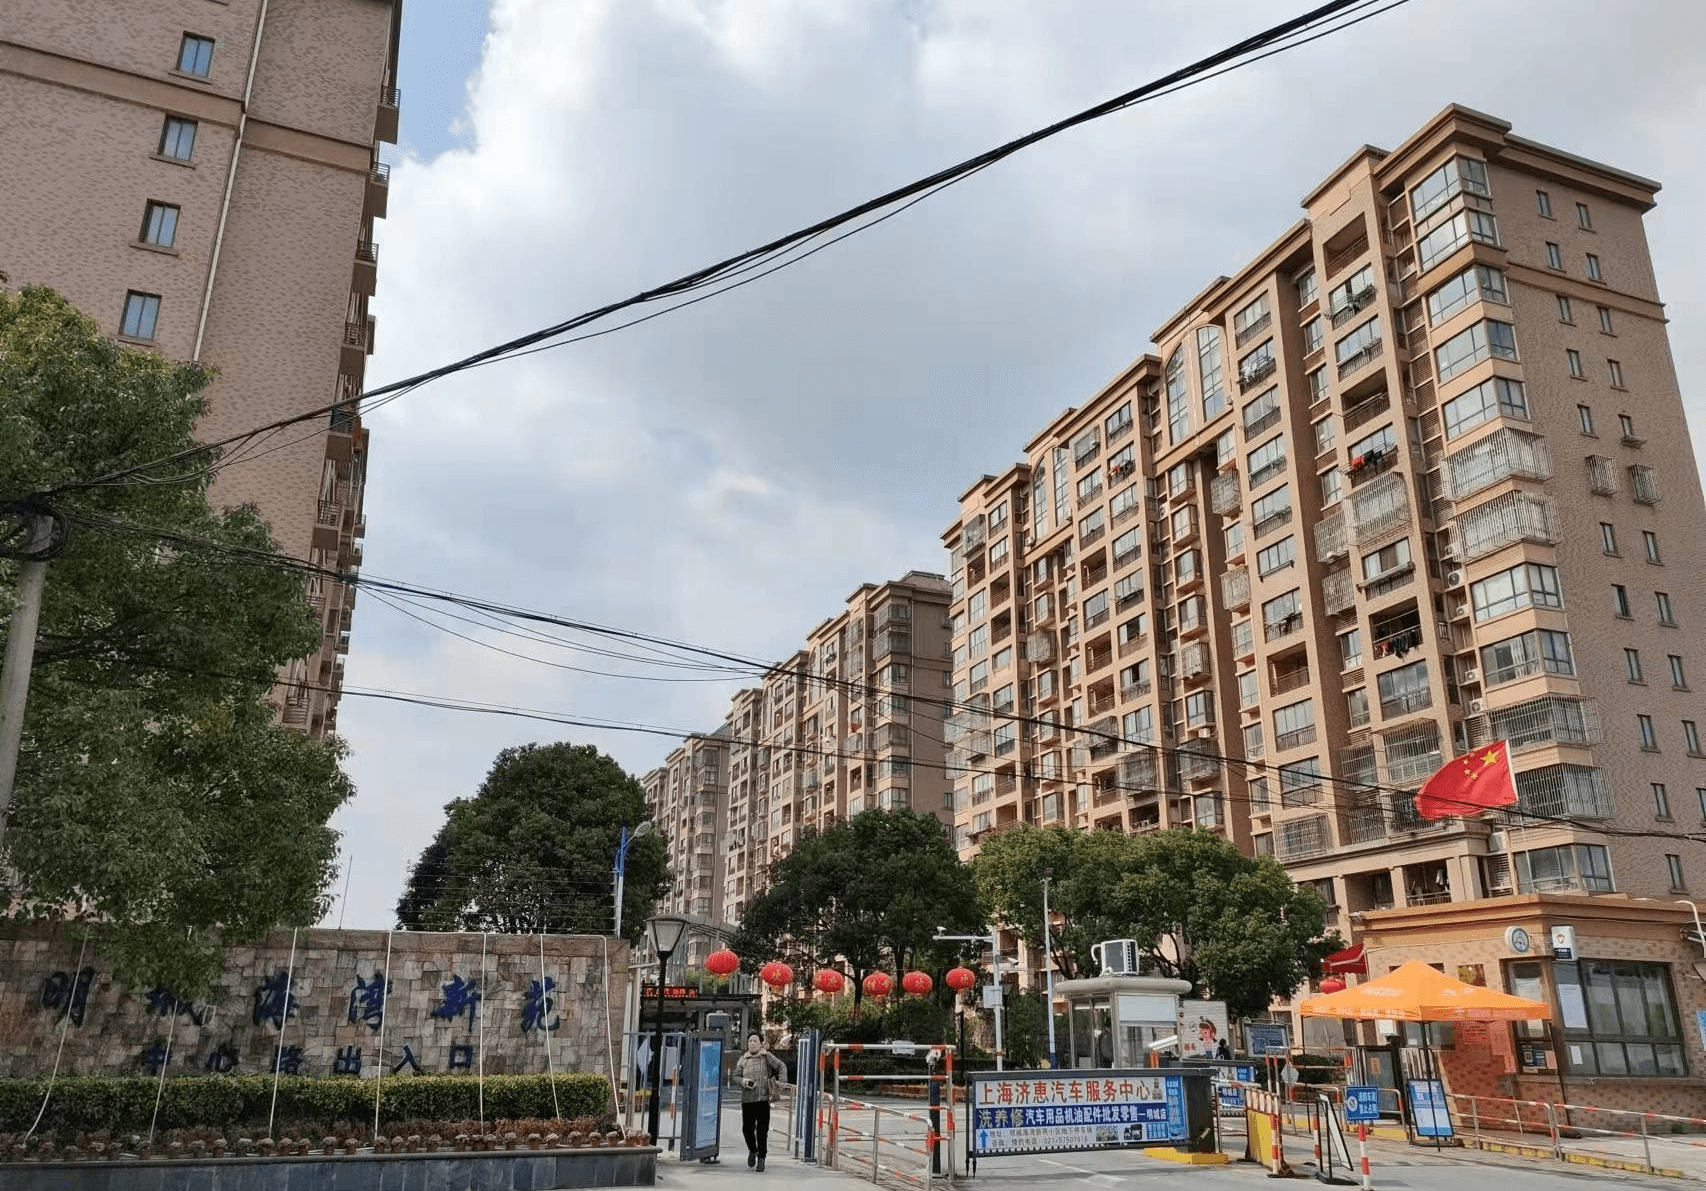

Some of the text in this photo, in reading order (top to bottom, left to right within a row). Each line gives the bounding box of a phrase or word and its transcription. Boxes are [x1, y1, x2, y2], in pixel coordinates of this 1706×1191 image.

[978, 1079, 1150, 1105] 上海济惠汽车服务中心
